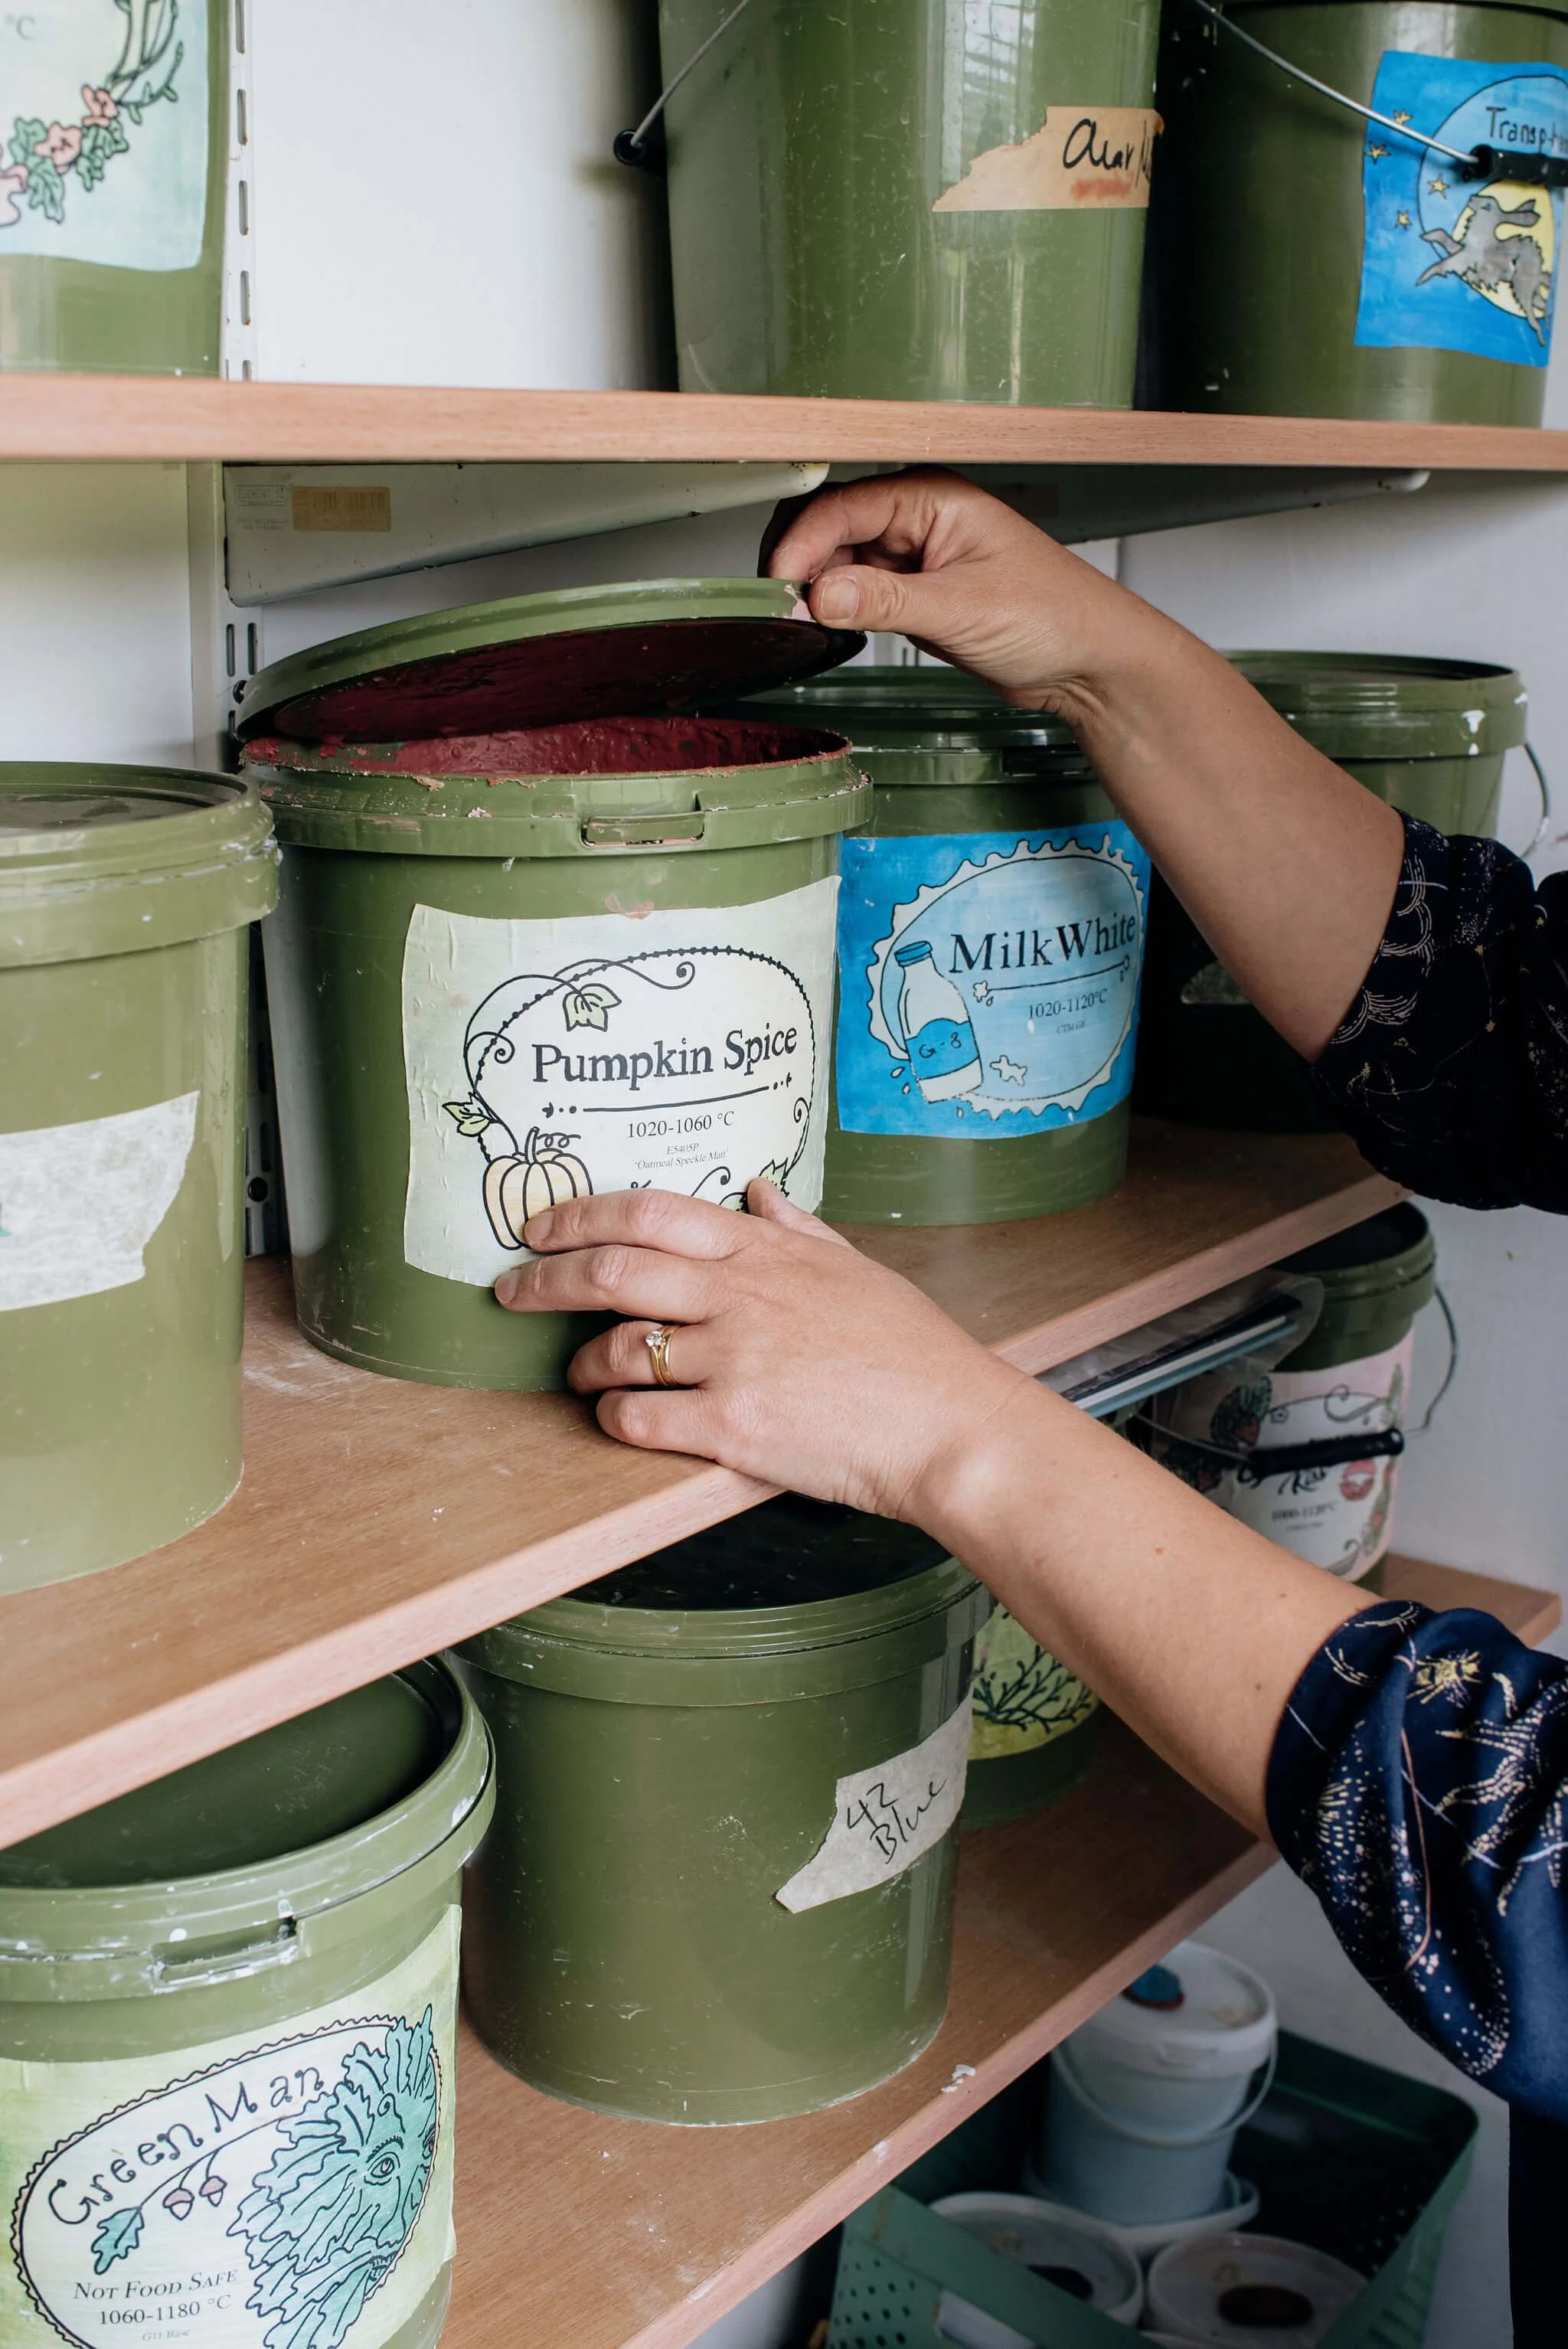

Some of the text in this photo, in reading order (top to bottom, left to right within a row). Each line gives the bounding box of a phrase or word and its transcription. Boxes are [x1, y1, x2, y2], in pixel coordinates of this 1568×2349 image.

[1028, 988, 1108, 1019] 1020-1120°C
[531, 1023, 798, 1091] Pumpkin Spice
[628, 1114, 712, 1139] 1020-1060
[675, 1154, 707, 1168] Speckle
[869, 1776, 949, 1864] Blue
[48, 2066, 325, 2225] Green Man
[100, 2301, 201, 2325] 1060-1180
